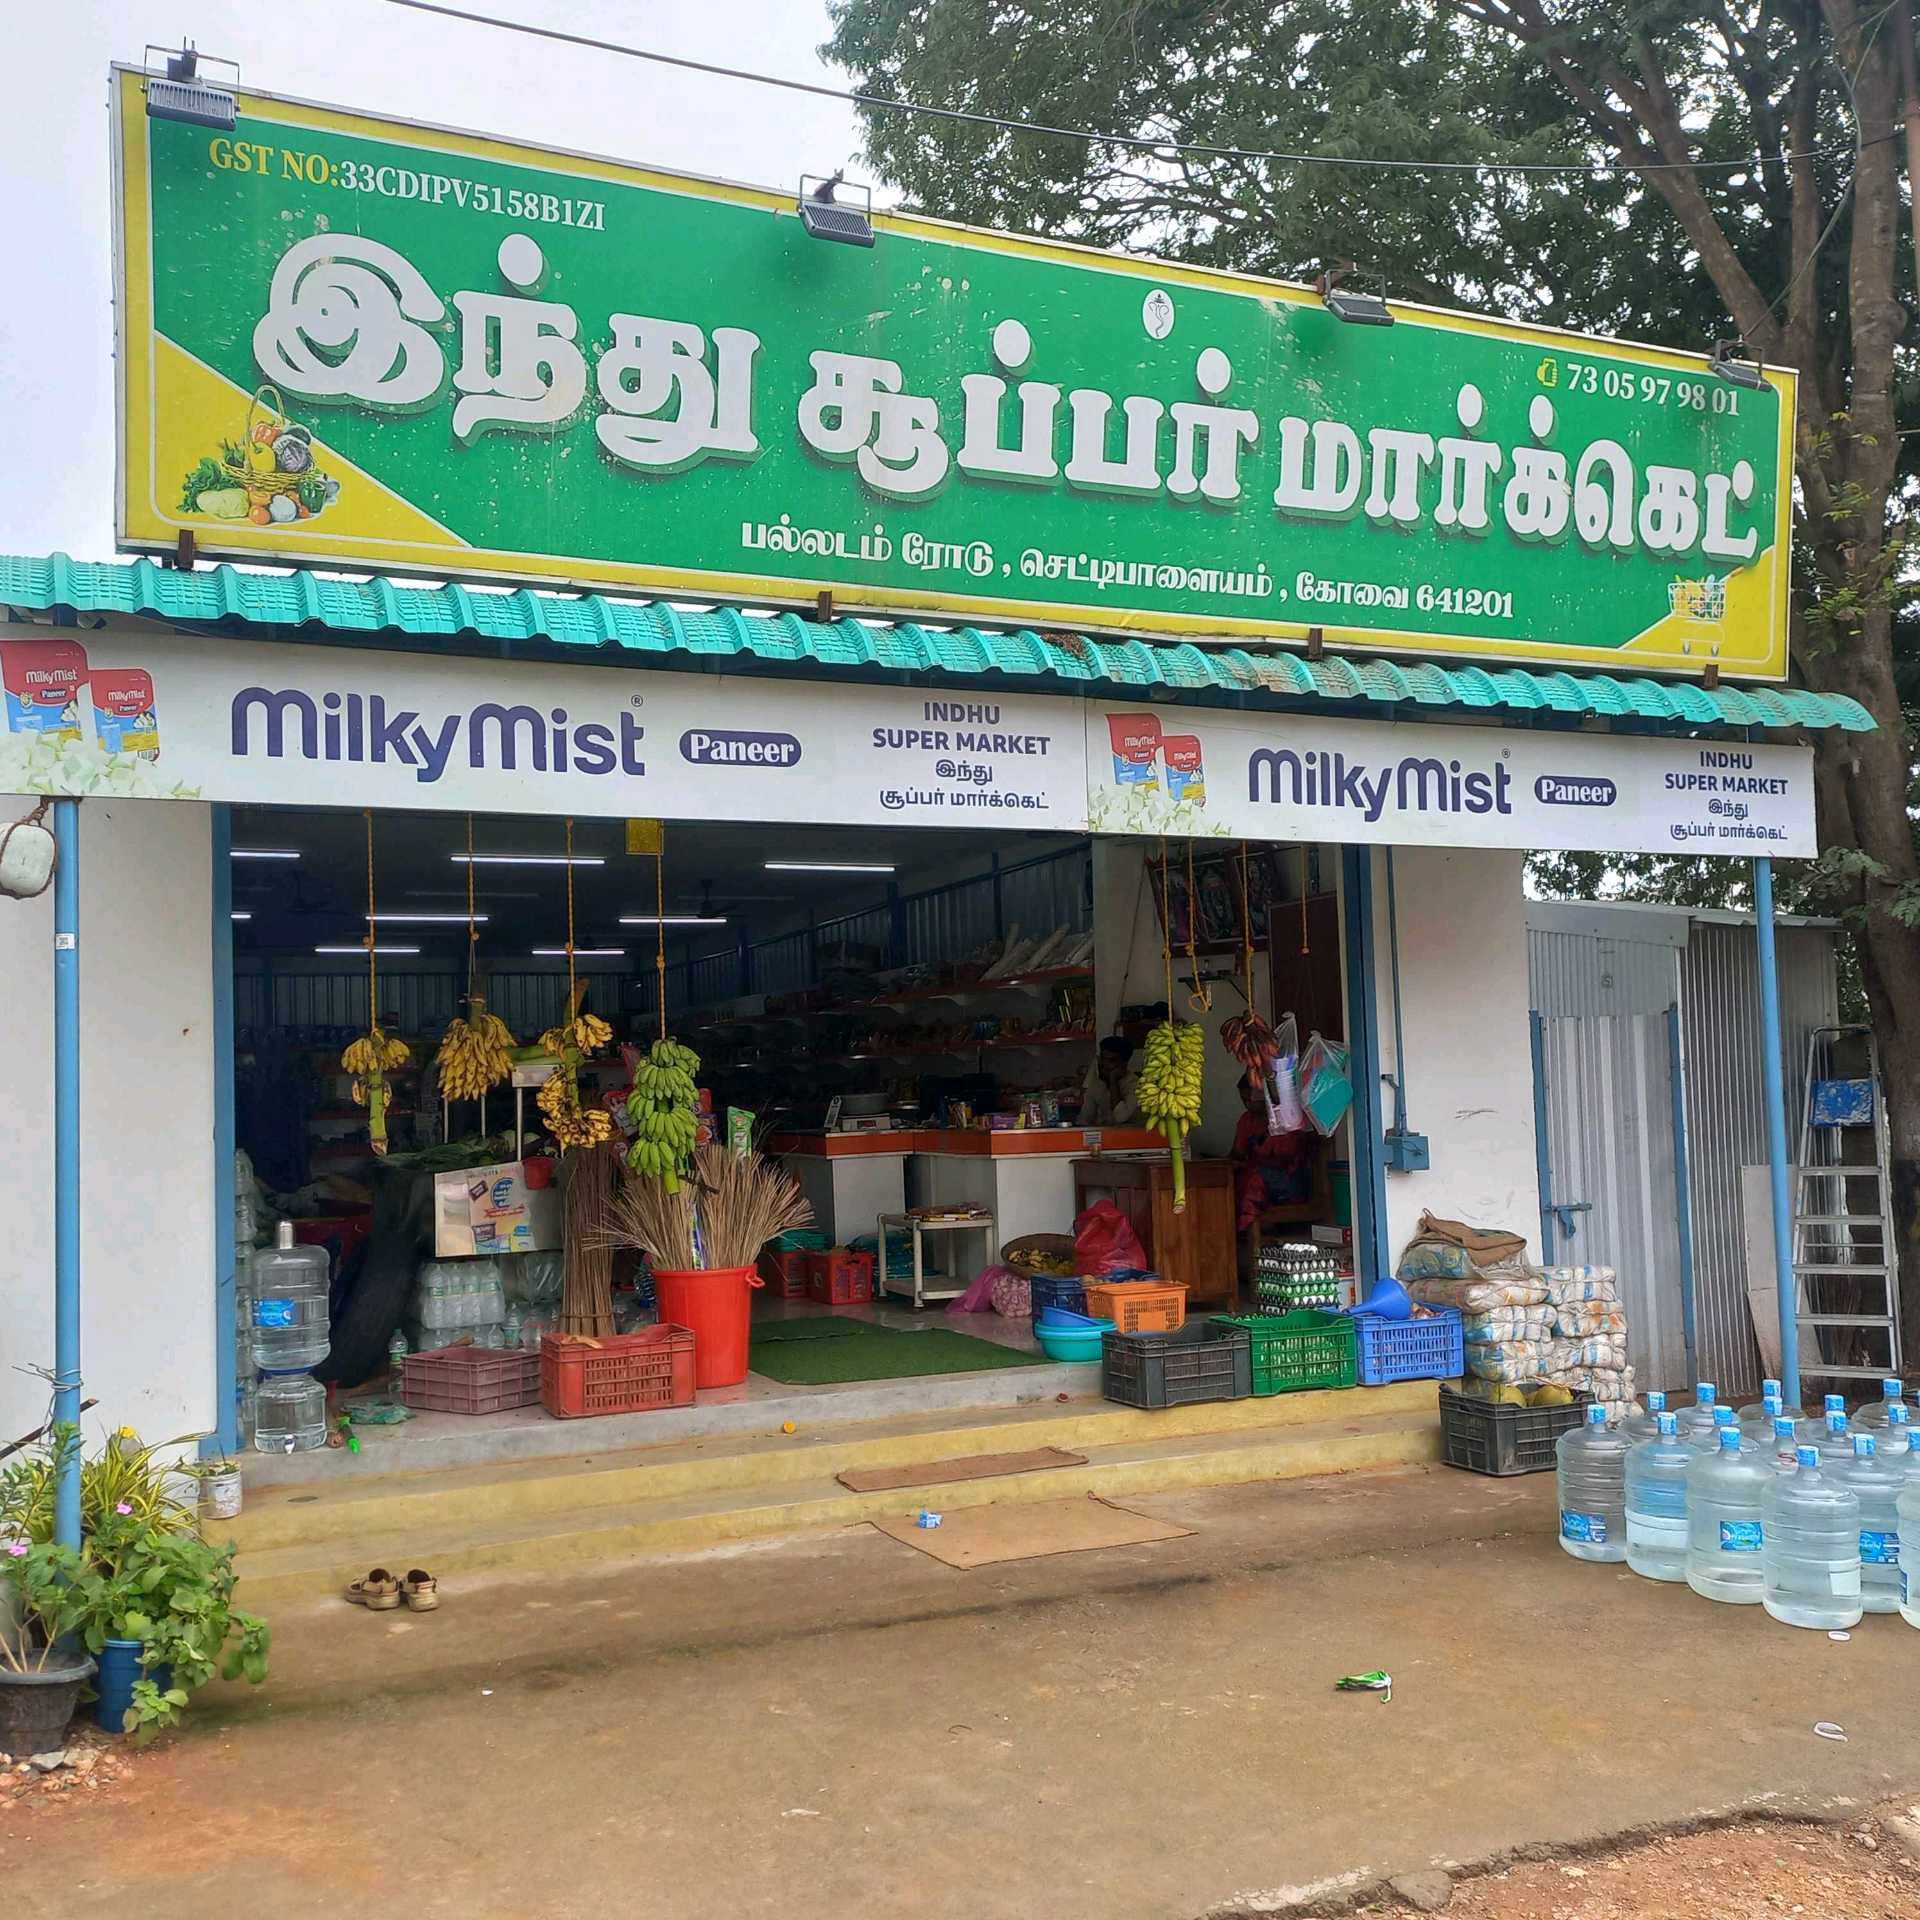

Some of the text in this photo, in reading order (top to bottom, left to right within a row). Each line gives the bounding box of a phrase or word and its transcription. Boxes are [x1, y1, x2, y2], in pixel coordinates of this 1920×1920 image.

[208, 138, 273, 176] GST
[252, 232, 1758, 560] இந்து சூப்பர் மார்க்கெட்
[1566, 362, 1740, 416] 73 05 97 98 01
[741, 513, 893, 562] பல்லடம்
[902, 532, 994, 577] ரோடு
[1020, 548, 1274, 597] செட்டிபாளையம்
[1295, 571, 1409, 609] கோவை
[1416, 584, 1514, 618] 641201
[924, 702, 1001, 725] INDHU
[690, 733, 796, 765] Paneer
[872, 728, 1051, 755] SUPER MARKET
[936, 758, 993, 786] இந்து
[1700, 751, 1753, 770] INDHU
[1541, 779, 1613, 803] Paneer
[1665, 773, 1788, 795] SUPER MARKET
[880, 786, 1049, 810] சூப்பர் மார்க்கெட்
[1708, 798, 1749, 821] இந்து
[1670, 821, 1788, 841] சூப்பர் மார்க்கெட்
